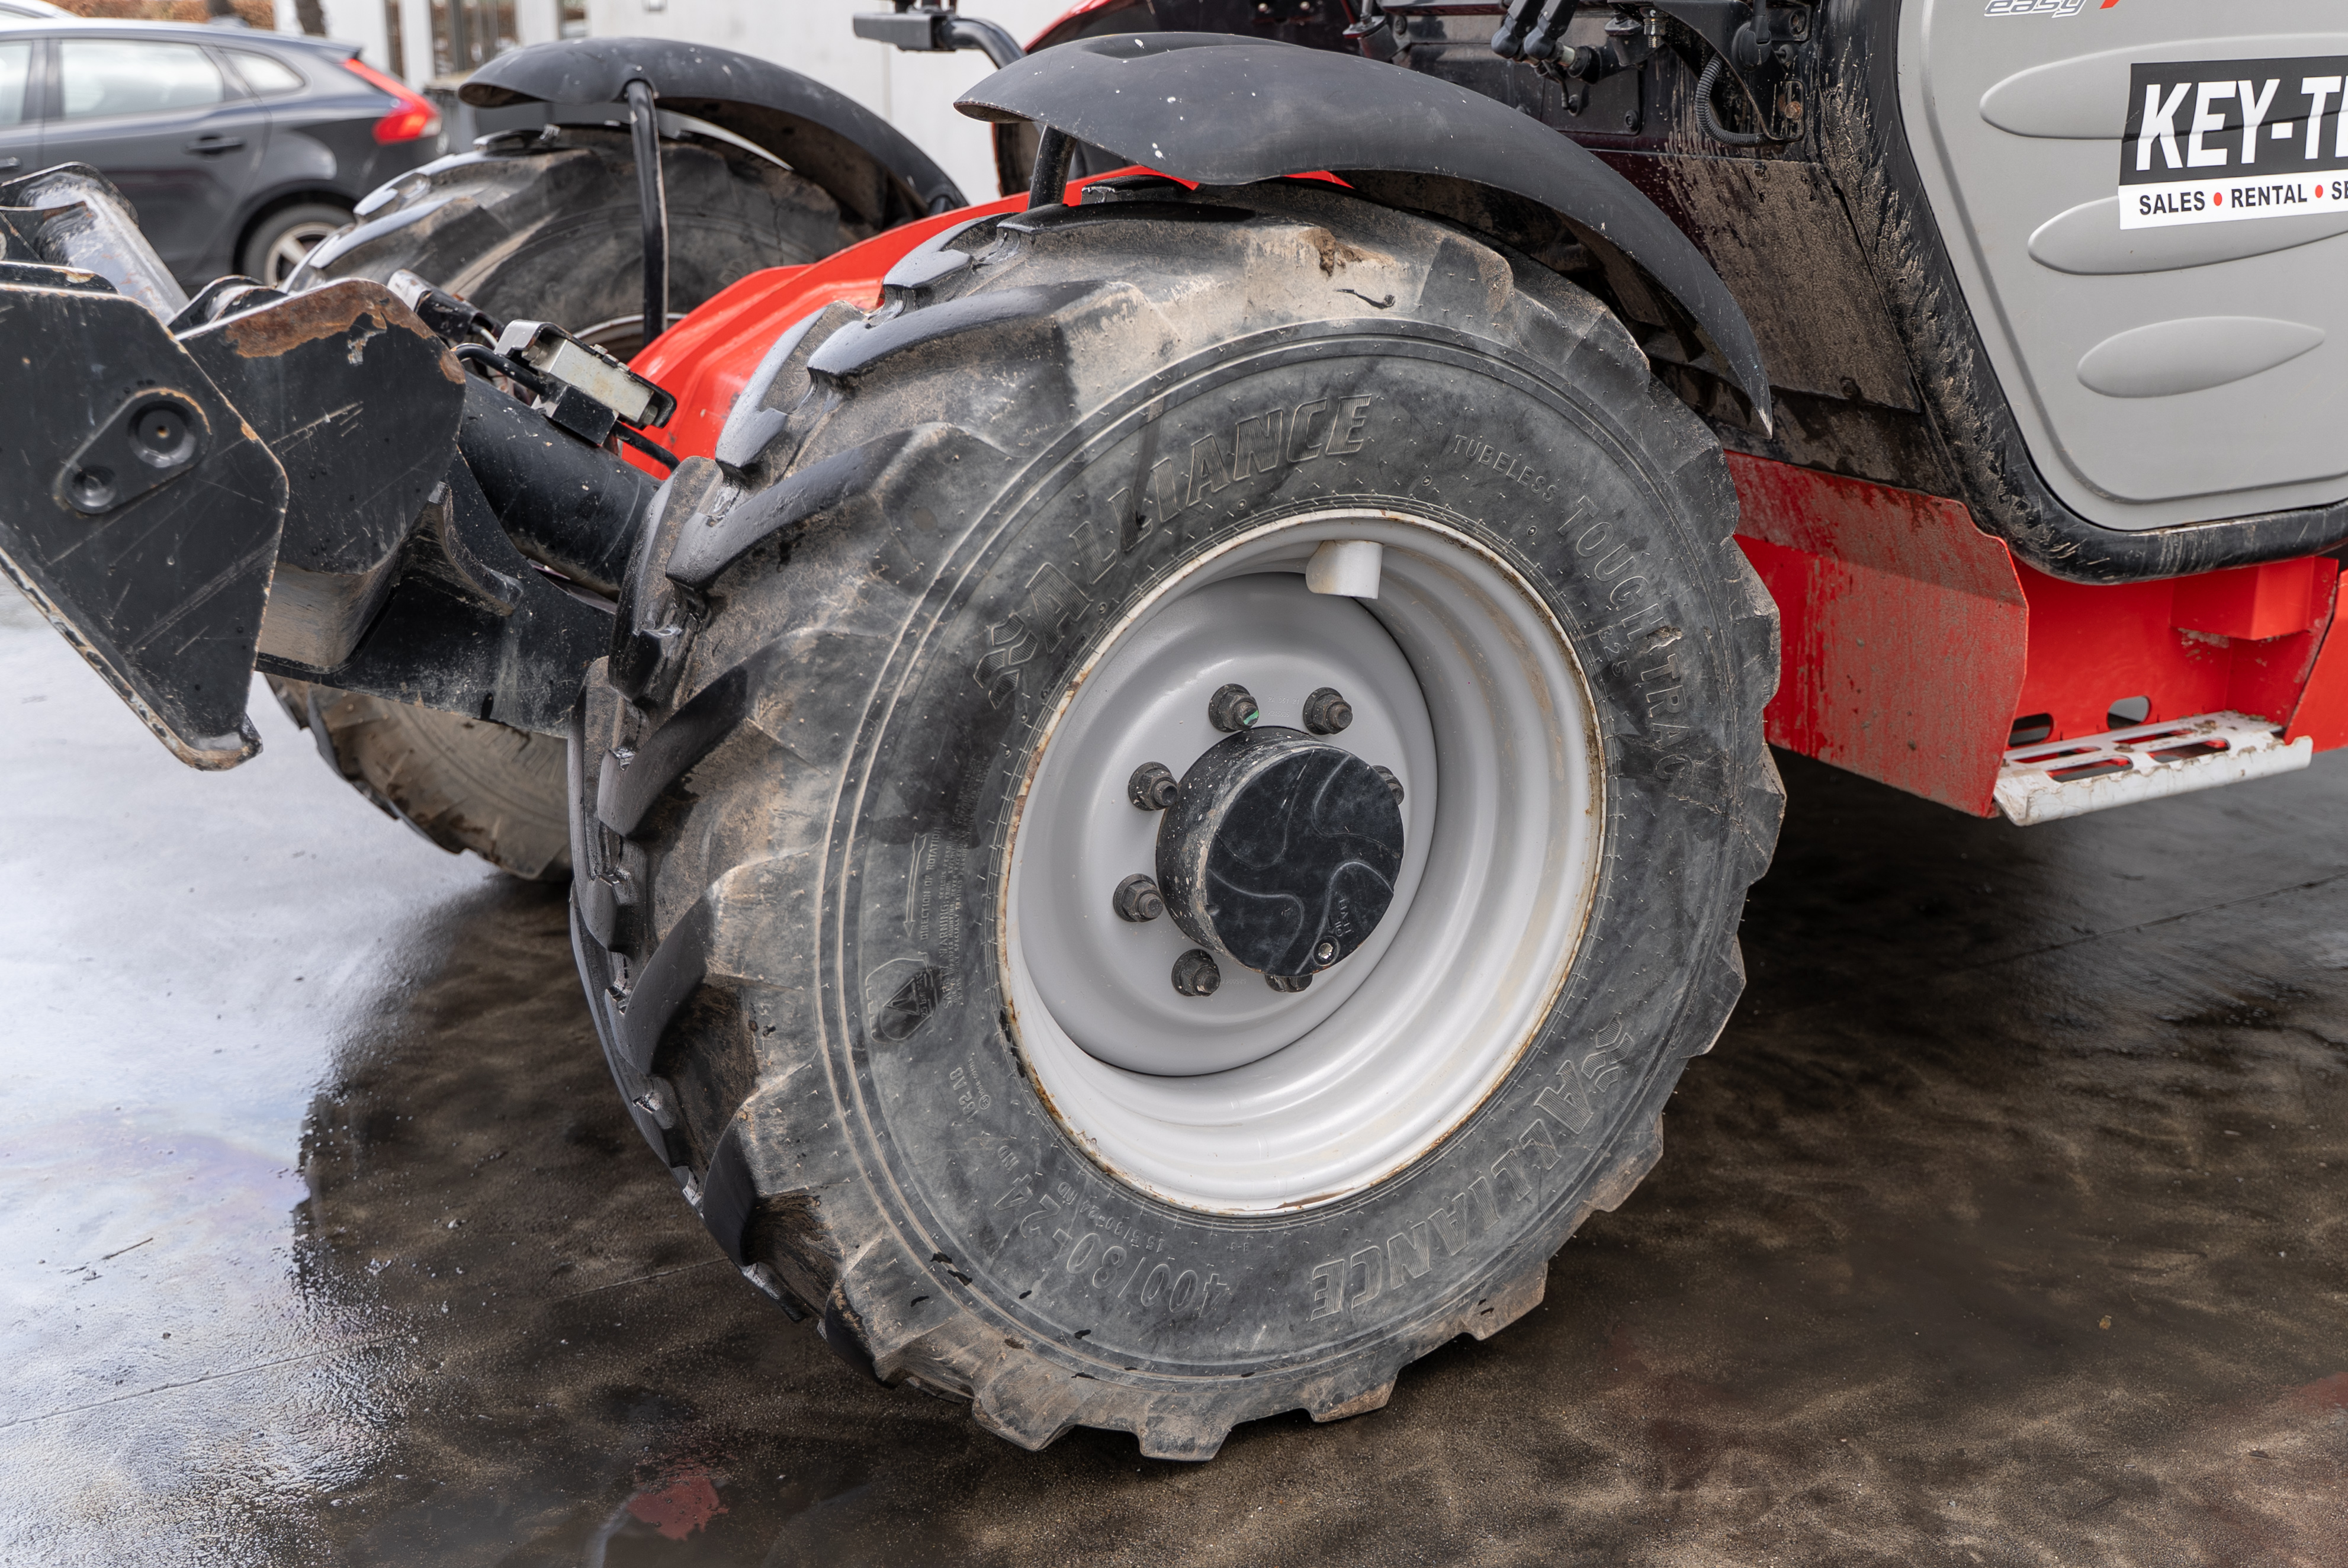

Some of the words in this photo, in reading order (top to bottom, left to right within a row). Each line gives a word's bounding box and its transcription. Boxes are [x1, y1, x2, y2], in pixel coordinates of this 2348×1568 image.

[2140, 190, 2205, 215] SALES
[2231, 184, 2307, 208] RENTAL
[1454, 434, 1558, 503] TUBELESS
[1025, 394, 1371, 653] ALLIANCE
[1557, 495, 1664, 642] TOUGH
[1640, 653, 1692, 780] TRAC
[1598, 625, 1628, 678] 325
[926, 827, 941, 870] ROTATION
[924, 875, 932, 886] OF
[920, 891, 932, 941] DIRECTION
[939, 901, 949, 957] WARNING:
[949, 1067, 967, 1091] A8
[959, 1091, 978, 1123] 162
[998, 1146, 1019, 1172] IND
[1058, 1182, 1078, 1205] IND
[1311, 1059, 1594, 1321] ALLIANCE
[994, 1174, 1227, 1318] 400/80-24
